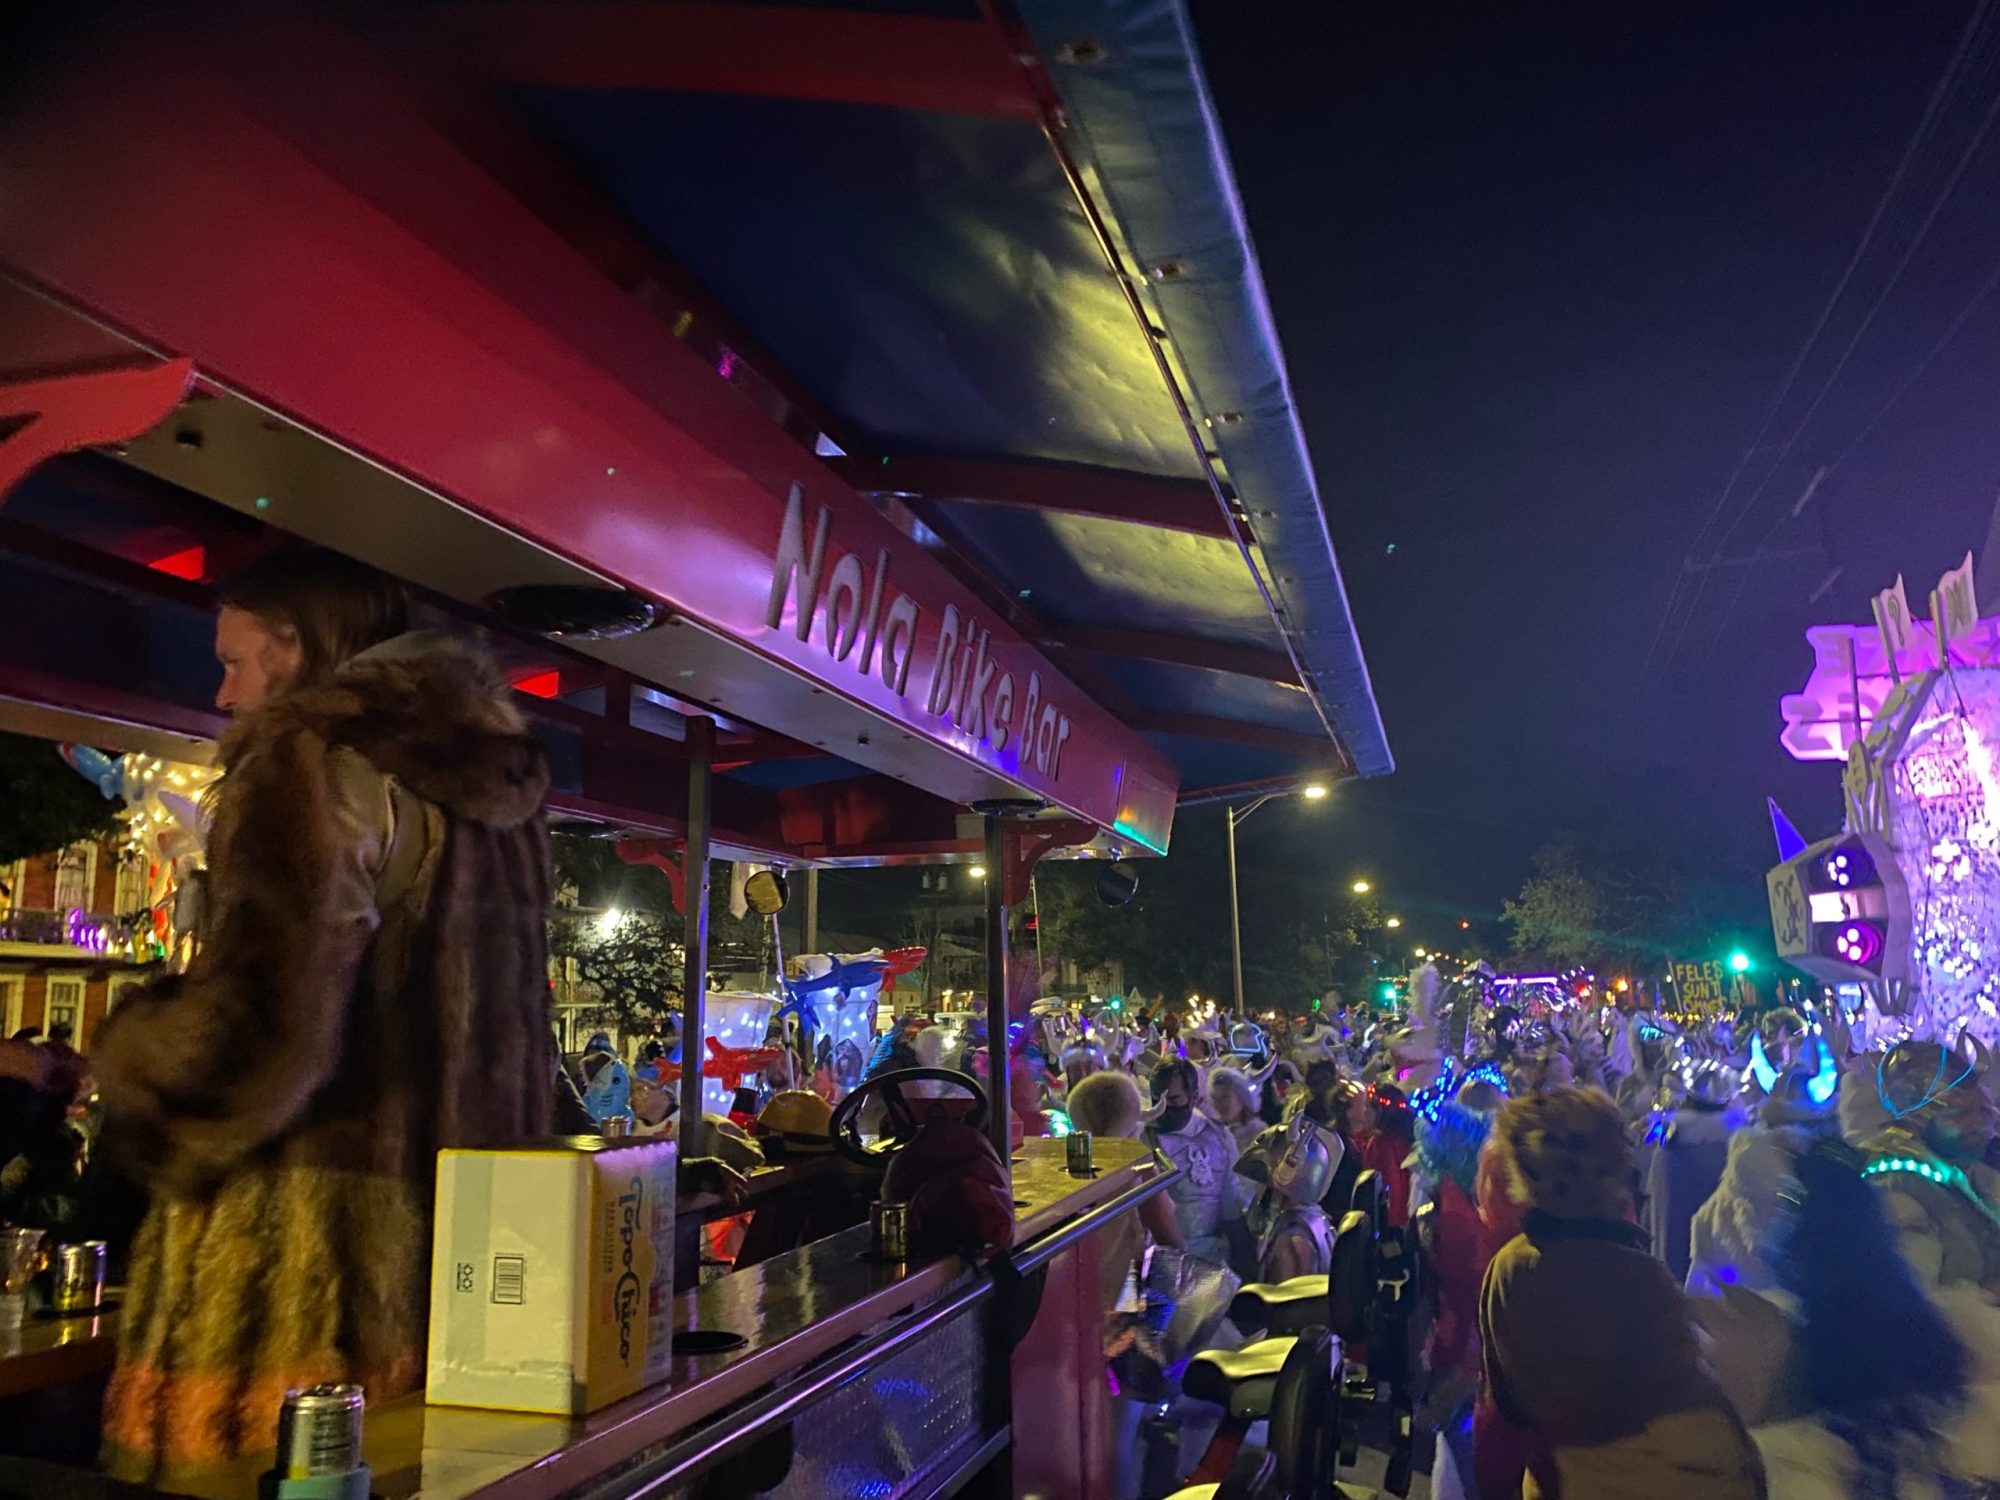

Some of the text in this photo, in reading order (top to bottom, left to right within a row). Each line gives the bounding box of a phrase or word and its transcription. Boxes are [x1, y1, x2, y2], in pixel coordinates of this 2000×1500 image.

[767, 481, 1070, 782] Nola Bike Bar
[1676, 961, 1723, 980] FELES
[1683, 979, 1722, 999] SUNT
[614, 1175, 643, 1367] Topo Chico
